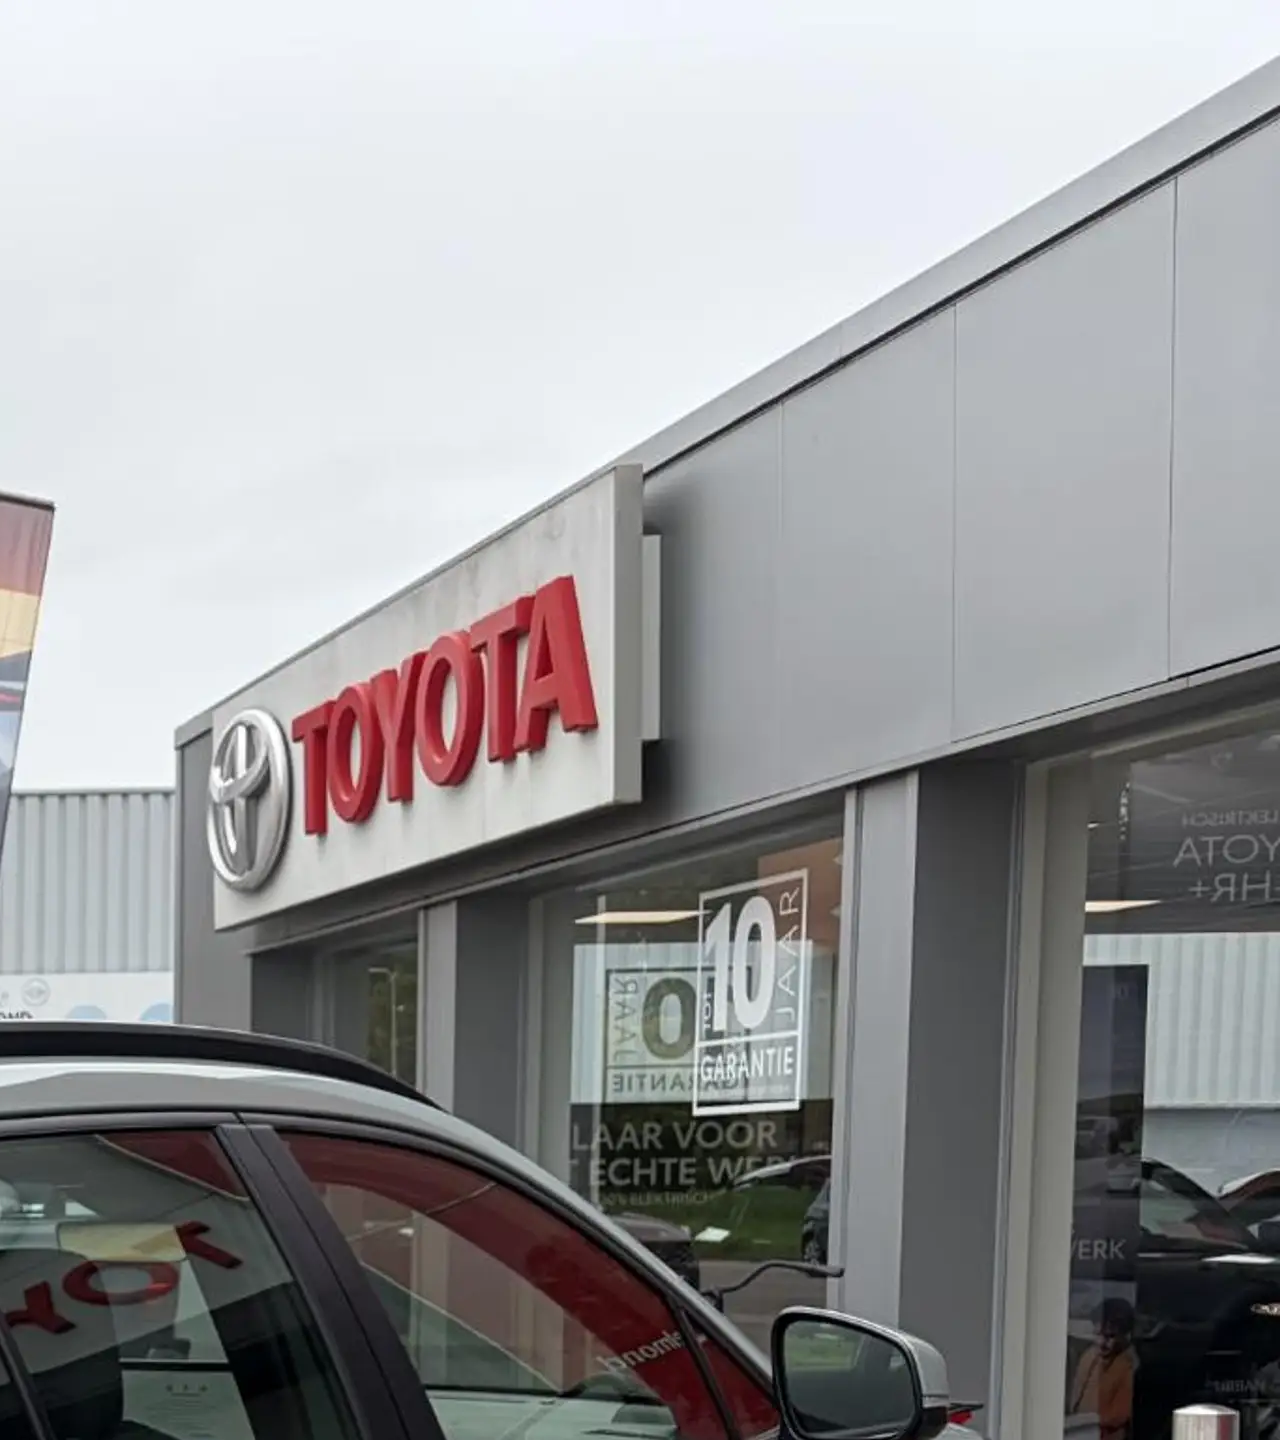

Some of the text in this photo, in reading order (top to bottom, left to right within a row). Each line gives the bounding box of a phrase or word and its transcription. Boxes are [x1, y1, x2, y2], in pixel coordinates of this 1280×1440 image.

[292, 573, 598, 837] TOYOTA
[704, 886, 801, 1033] 10 JAAR
[699, 1045, 795, 1082] GARANTIE
[573, 1121, 778, 1150] LAAR VOOR
[591, 1156, 697, 1187] ECHTE
